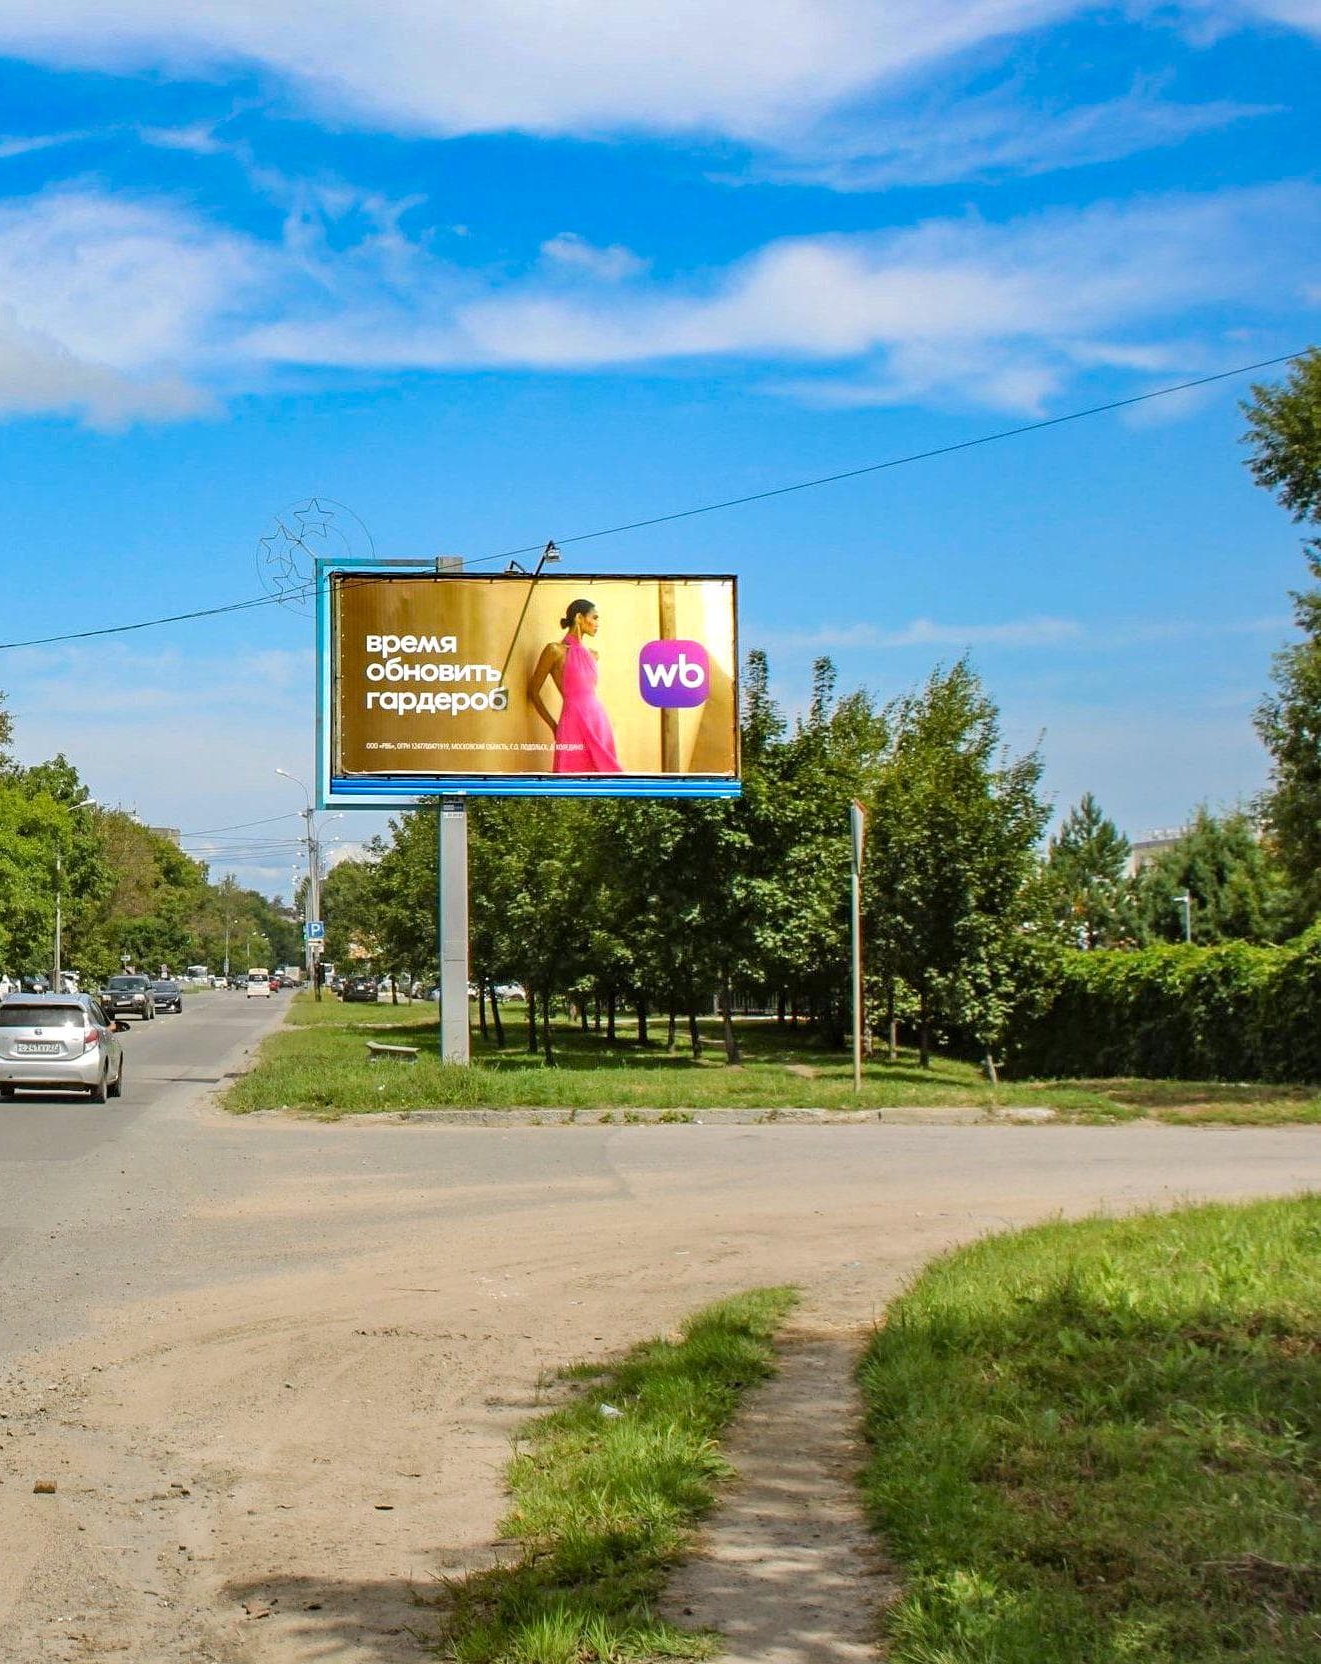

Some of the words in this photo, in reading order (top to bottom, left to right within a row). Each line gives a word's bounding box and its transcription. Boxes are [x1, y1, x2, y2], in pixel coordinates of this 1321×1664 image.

[366, 635, 457, 658] время
[366, 656, 502, 682] обновить
[642, 653, 705, 689] wb
[366, 686, 508, 716] гардероб
[366, 742, 379, 750] ООО
